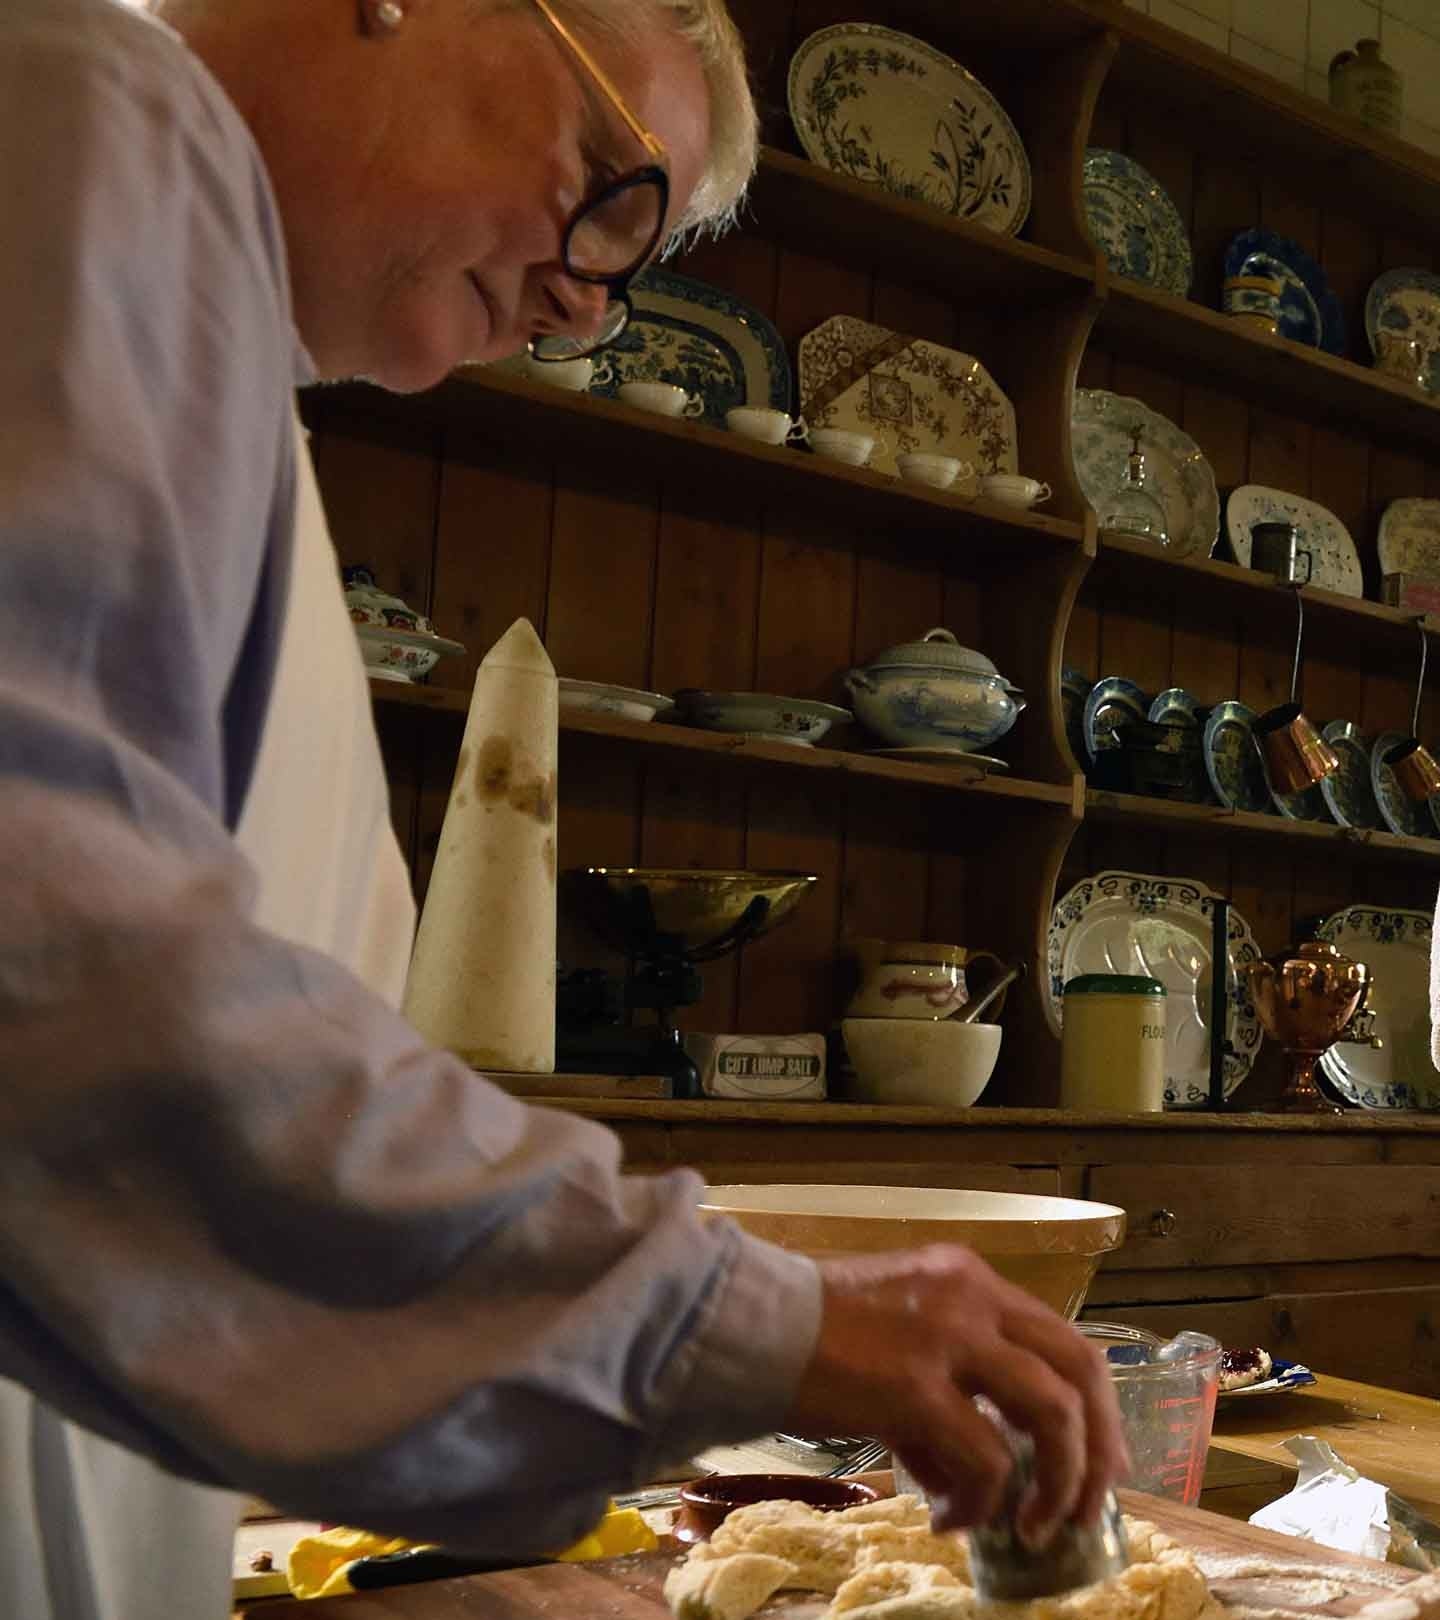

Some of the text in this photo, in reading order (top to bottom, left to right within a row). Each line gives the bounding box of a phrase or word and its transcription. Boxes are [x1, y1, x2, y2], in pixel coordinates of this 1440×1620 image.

[725, 1055, 814, 1075] CUT LUMP SALT
